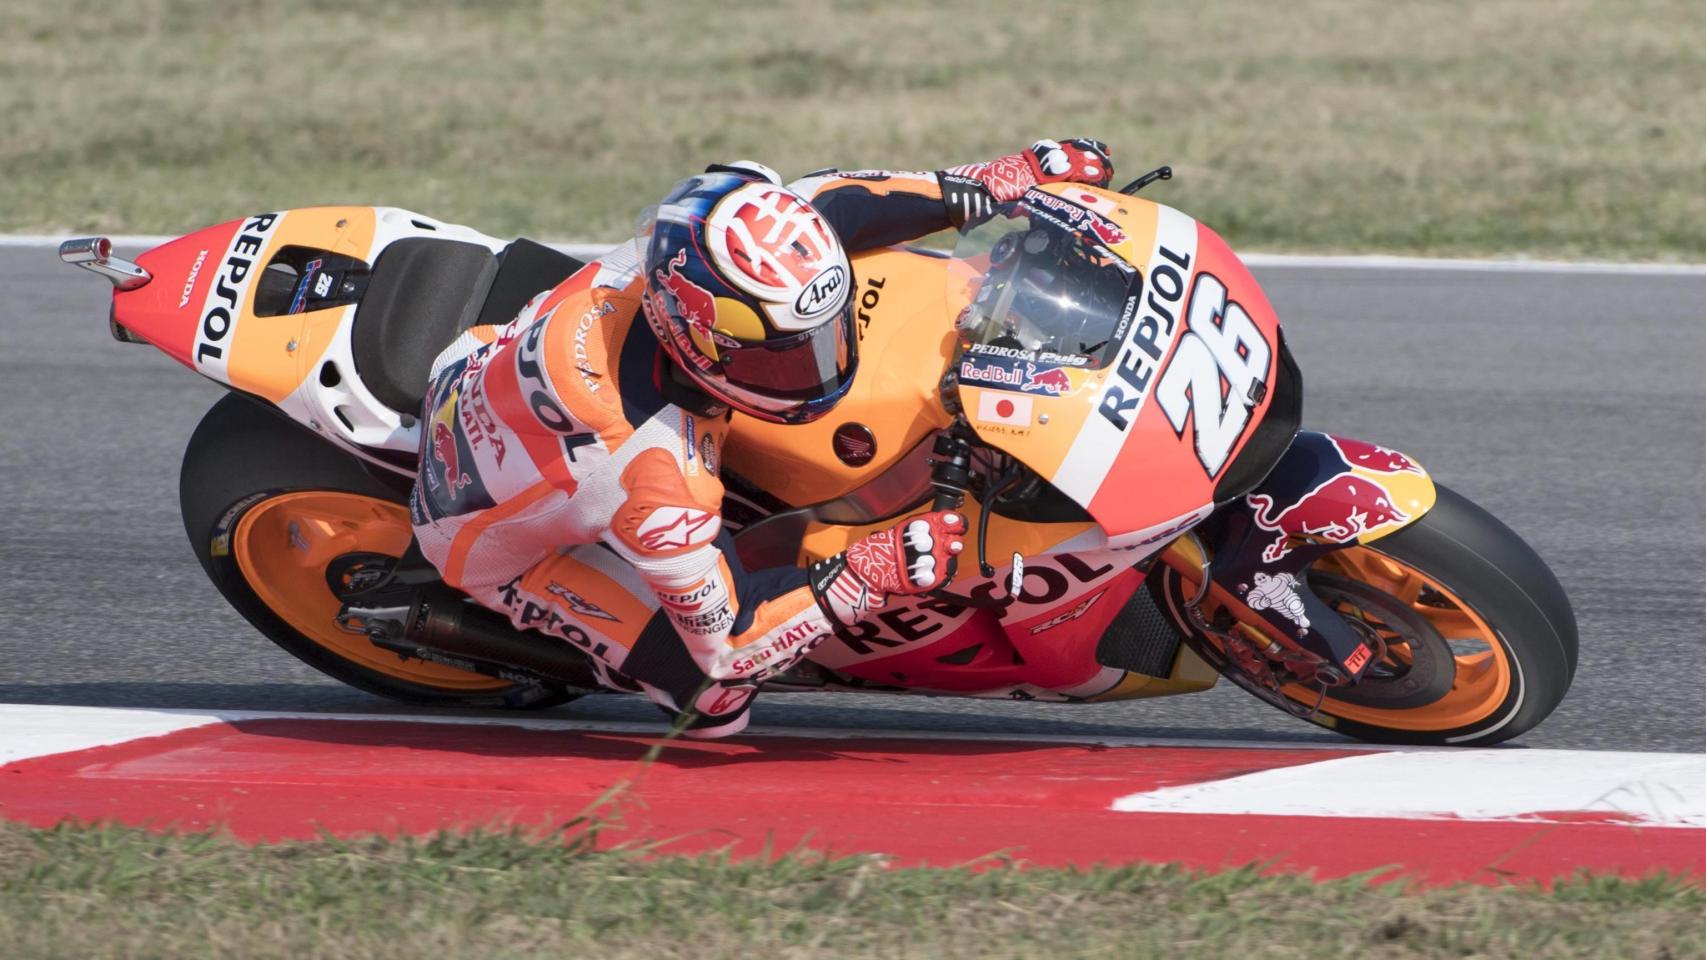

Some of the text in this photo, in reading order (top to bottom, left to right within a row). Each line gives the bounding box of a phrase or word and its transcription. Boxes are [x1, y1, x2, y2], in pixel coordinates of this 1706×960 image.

[179, 249, 209, 309] HONDA
[198, 213, 278, 364] REPSOL
[315, 272, 333, 297] 26
[803, 267, 841, 312] Arai
[858, 277, 886, 341] SOL
[1115, 295, 1137, 340] HONDA
[970, 343, 1036, 361] PEDROSA
[1038, 351, 1088, 366] Puig
[1099, 245, 1191, 432] REPSOL
[961, 361, 1023, 385] Red Bull
[1154, 270, 1272, 482] 26
[771, 620, 818, 653] HATI.
